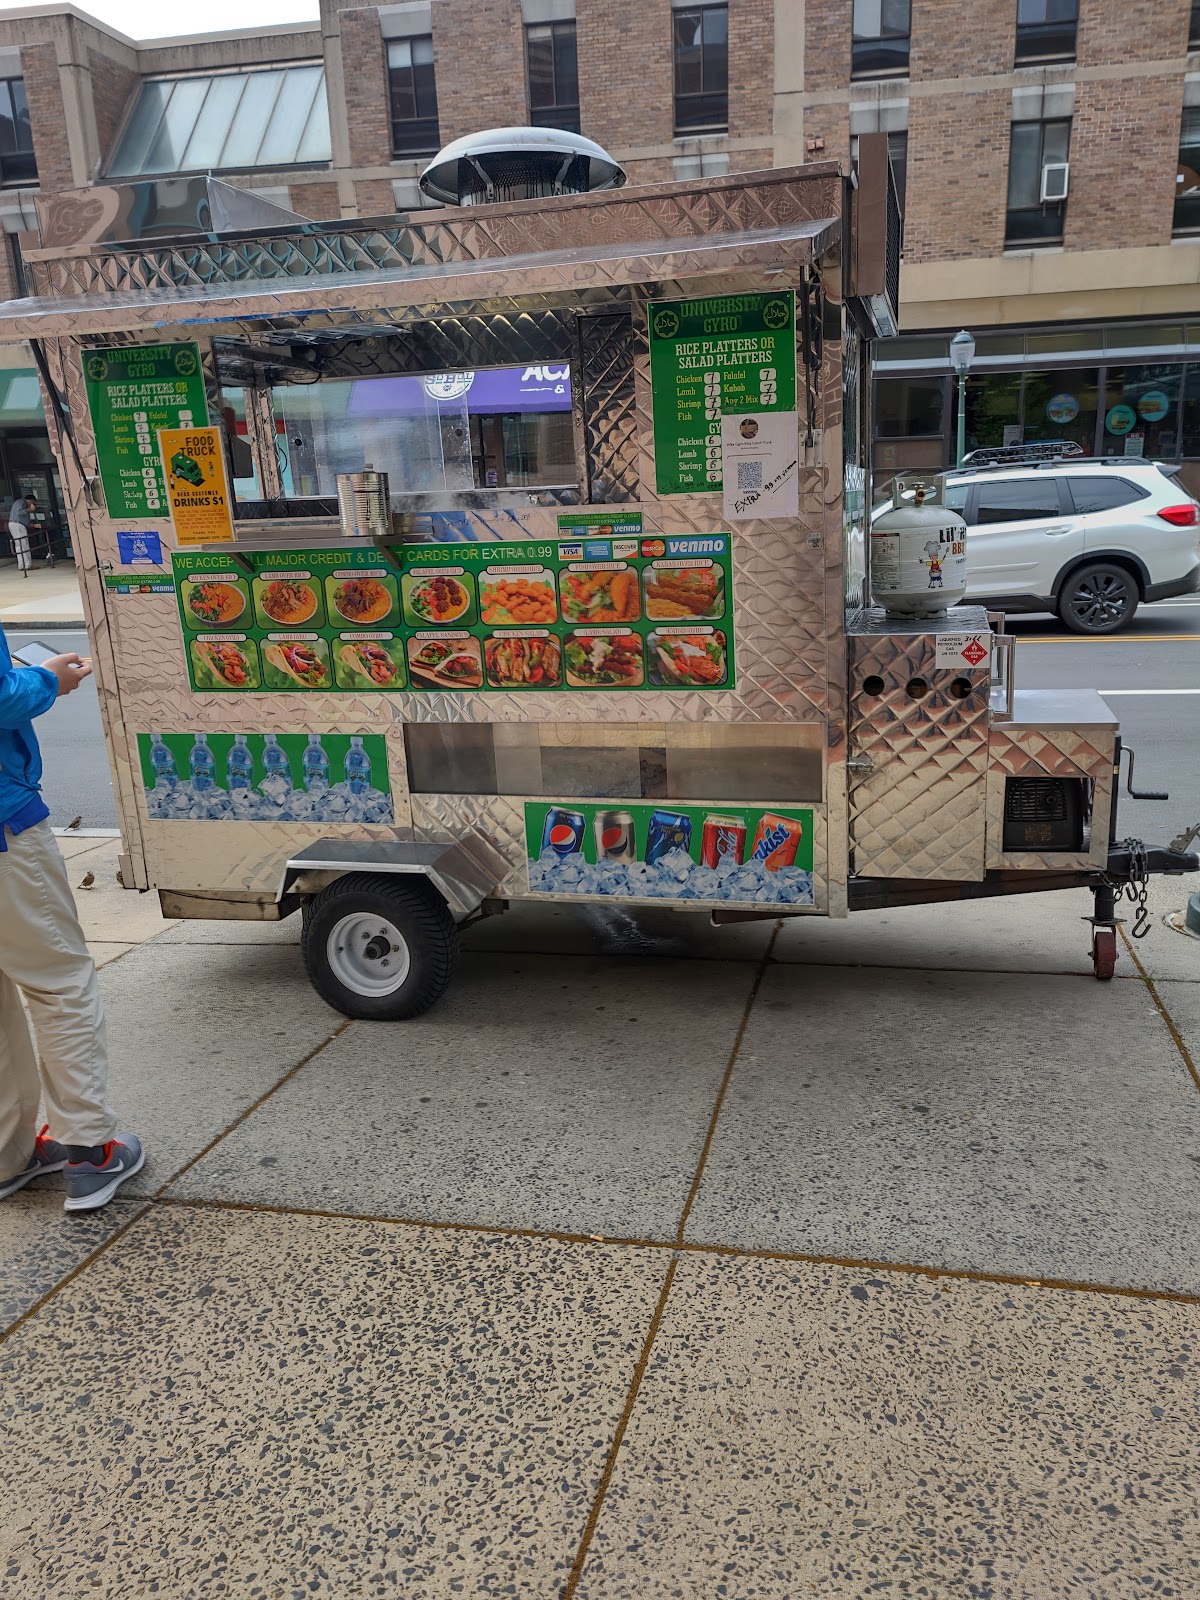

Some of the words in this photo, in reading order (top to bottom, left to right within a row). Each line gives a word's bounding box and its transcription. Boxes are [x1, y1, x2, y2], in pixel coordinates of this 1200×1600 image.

[680, 296, 764, 317] UNIVERSITY
[704, 315, 742, 332] GYRO
[675, 343, 699, 356] RICE
[702, 338, 758, 354] PLATTERS
[760, 337, 775, 348] OR
[106, 346, 172, 363] UNIVERSITY
[679, 355, 714, 369] SALAD
[716, 351, 772, 366] PLATTERS
[128, 363, 156, 376] GYRO
[676, 375, 702, 384] Chicken
[707, 373, 714, 382] 7
[724, 371, 746, 380] Falafel
[763, 370, 770, 380] 7
[107, 385, 127, 396] RICE
[130, 383, 174, 396] PLATTERS
[176, 382, 188, 392] OR
[554, 384, 564, 394] &
[677, 388, 695, 396] Lamb
[724, 384, 745, 393] Kabab
[112, 397, 140, 408] SALAD
[142, 394, 187, 406] PLATTERS
[678, 400, 701, 409] Shrimp
[709, 423, 721, 434] GY
[186, 436, 214, 446] FOOD
[678, 438, 704, 446] Chicken
[708, 436, 714, 444] 6
[180, 446, 216, 456] TRUCK
[678, 450, 697, 458] Lamb
[143, 456, 160, 466] GYR
[678, 462, 702, 470] Shrimp
[679, 474, 694, 482] Fish
[174, 498, 210, 507] DRINKS
[213, 496, 224, 506] $1
[735, 492, 761, 513] EXTRA
[668, 540, 724, 552] venmo
[175, 556, 193, 568] WE
[196, 555, 234, 568] ACCEP
[266, 554, 307, 565] MAJOR
[310, 552, 352, 564] CREDIT
[356, 552, 365, 563] &
[407, 550, 450, 562] CARDS
[454, 548, 479, 560] FOR
[482, 547, 526, 560] EXTRA
[527, 546, 552, 557] 0.99
